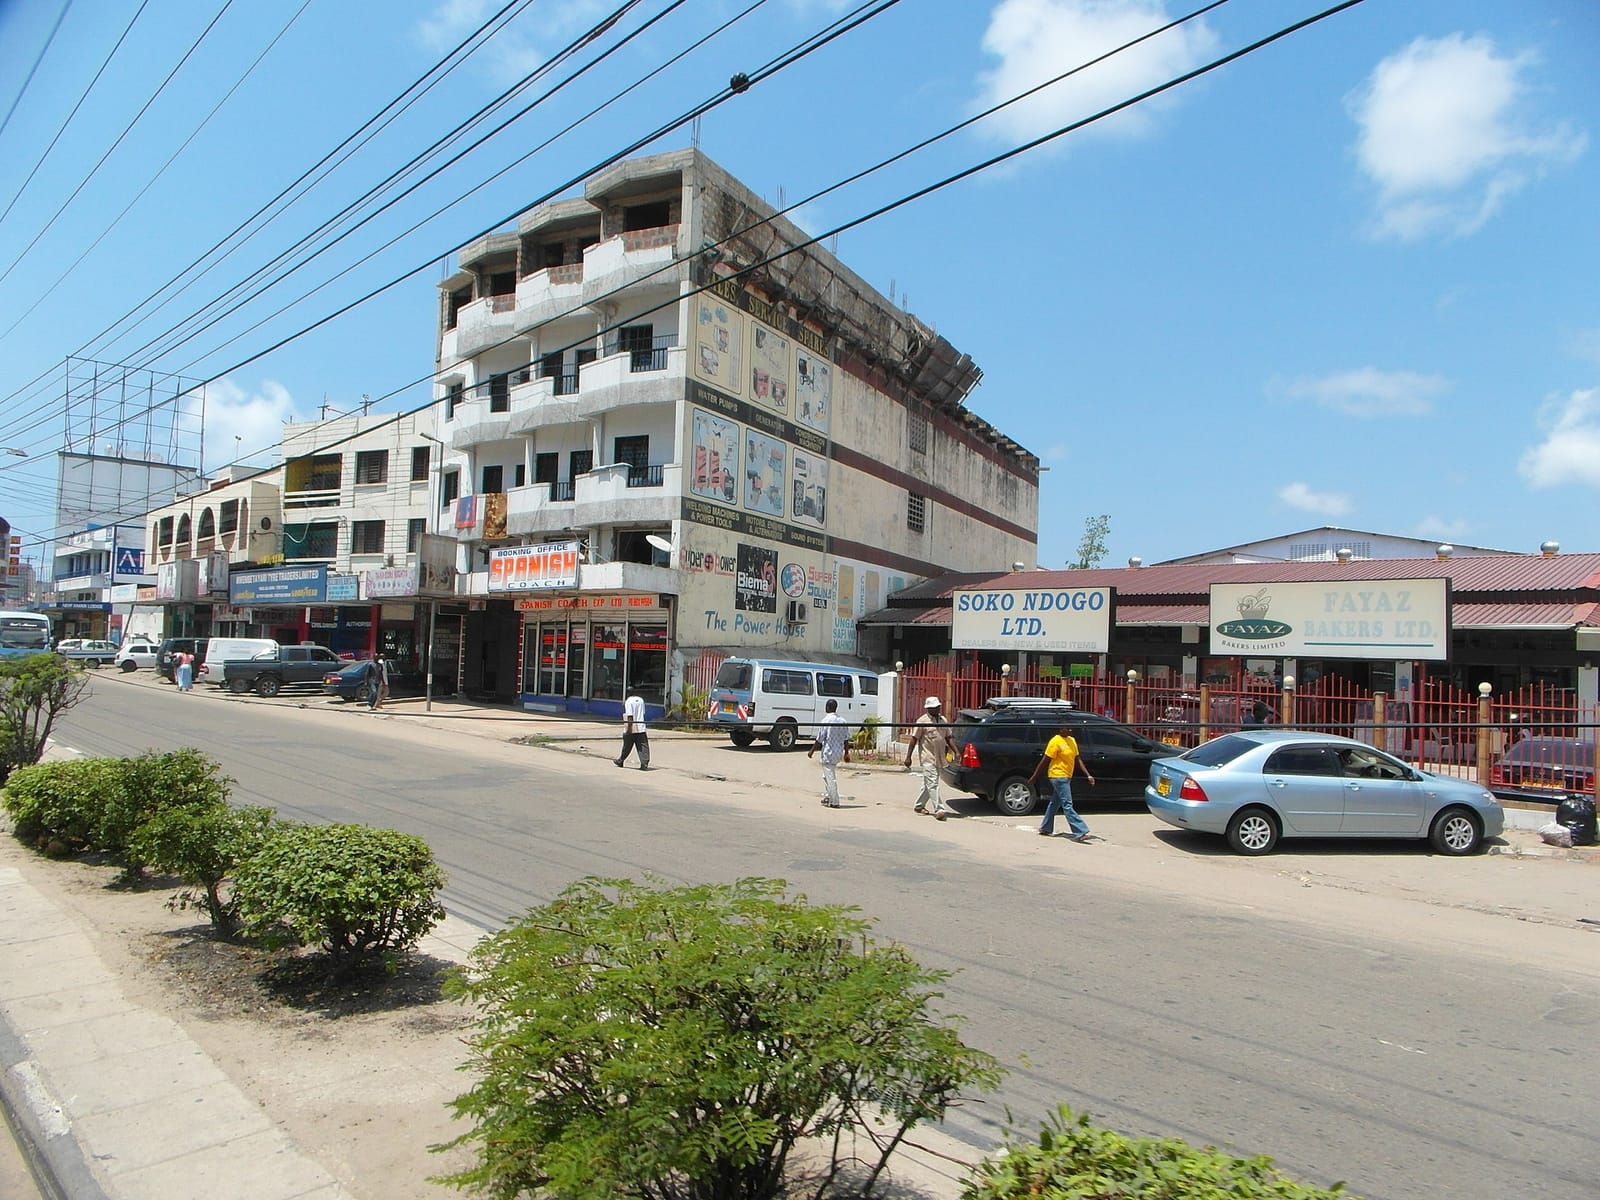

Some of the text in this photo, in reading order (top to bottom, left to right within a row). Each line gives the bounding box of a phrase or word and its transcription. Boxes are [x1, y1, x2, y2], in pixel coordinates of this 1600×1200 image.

[697, 389, 738, 413] WATER PUMPS
[685, 500, 740, 521] WELDING MACHINES
[696, 513, 715, 525] POWER
[715, 517, 733, 529] TOOLS
[497, 543, 568, 557] BOOKING OFFICE
[490, 552, 576, 584] SPANISH
[507, 579, 566, 589] COACH
[737, 571, 769, 592] Biema
[519, 601, 552, 609] SPANISH
[557, 599, 588, 608] COACH
[958, 591, 1104, 612] SOKO NDOGO
[1323, 590, 1413, 612] FAYAZ
[704, 610, 806, 638] The Power House
[1000, 617, 1047, 636] LTD.
[1222, 625, 1286, 634] FAYAZ
[1303, 620, 1438, 638] BAKERS LTD.
[961, 639, 997, 647] DEALERS
[1014, 640, 1035, 648] NEW
[1044, 640, 1067, 649] USED
[1068, 641, 1097, 649] ITEMS
[1221, 640, 1286, 650] BAKERS LIMITED
